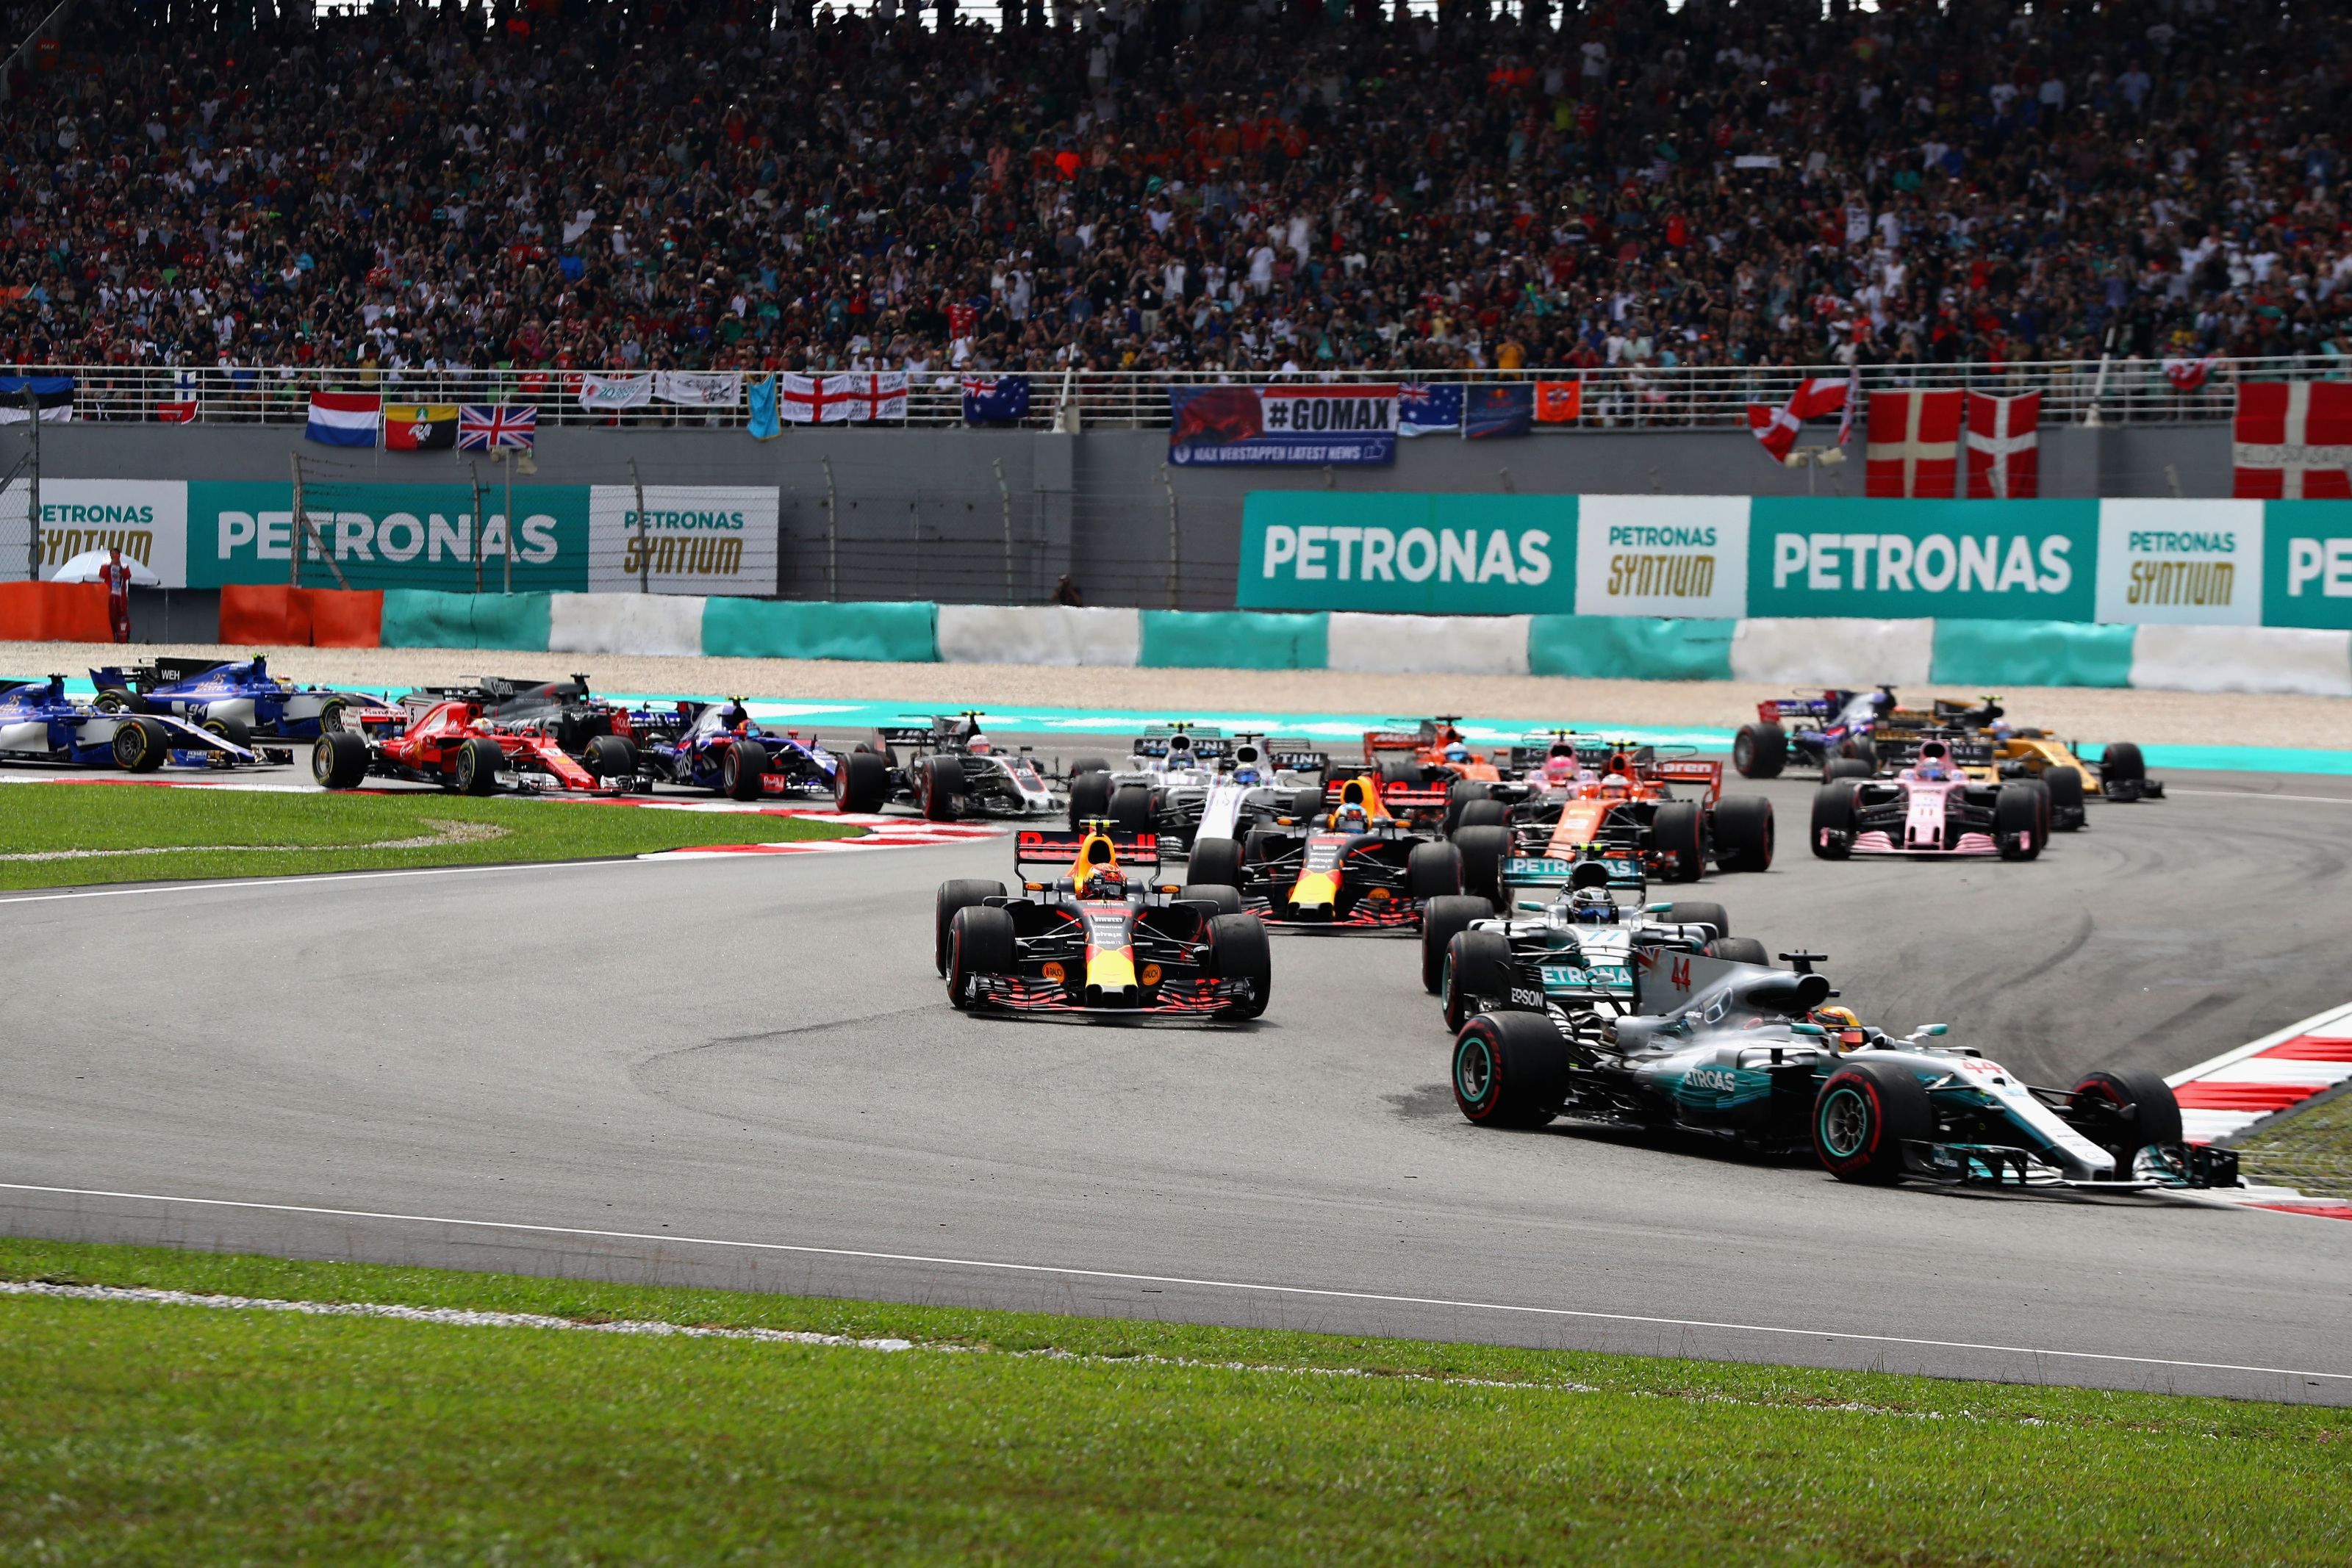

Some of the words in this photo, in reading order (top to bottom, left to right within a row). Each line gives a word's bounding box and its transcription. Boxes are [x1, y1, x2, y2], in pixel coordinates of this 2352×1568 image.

[1268, 398, 1390, 431] #GOMAX
[1194, 445, 1217, 461] MAX
[1219, 445, 1286, 461] VERSTAPPEN
[1287, 445, 1324, 460] LATEST
[1327, 445, 1360, 460] NEWS
[624, 511, 744, 530] PETRONAS
[218, 511, 558, 564] PETRONAS
[1608, 525, 1717, 547] PETRONAS
[2129, 531, 2235, 553] PETRONAS
[623, 536, 744, 575] SYNTIUM
[1262, 525, 1552, 586] PETRONAS
[1774, 532, 2072, 594] PETRONAS
[1607, 554, 1715, 598] SYNTIUM
[2127, 561, 2235, 606] SYNTIUM
[161, 669, 181, 680] WEH
[492, 680, 514, 695] GRO
[410, 708, 415, 724] 5
[1115, 832, 1157, 860] ull
[1513, 858, 1632, 874] PETRAS
[1540, 966, 1632, 982] ETRONA
[1671, 957, 1690, 993] 44
[1510, 988, 1543, 1007] EPSON
[1962, 1061, 2003, 1074] 44
